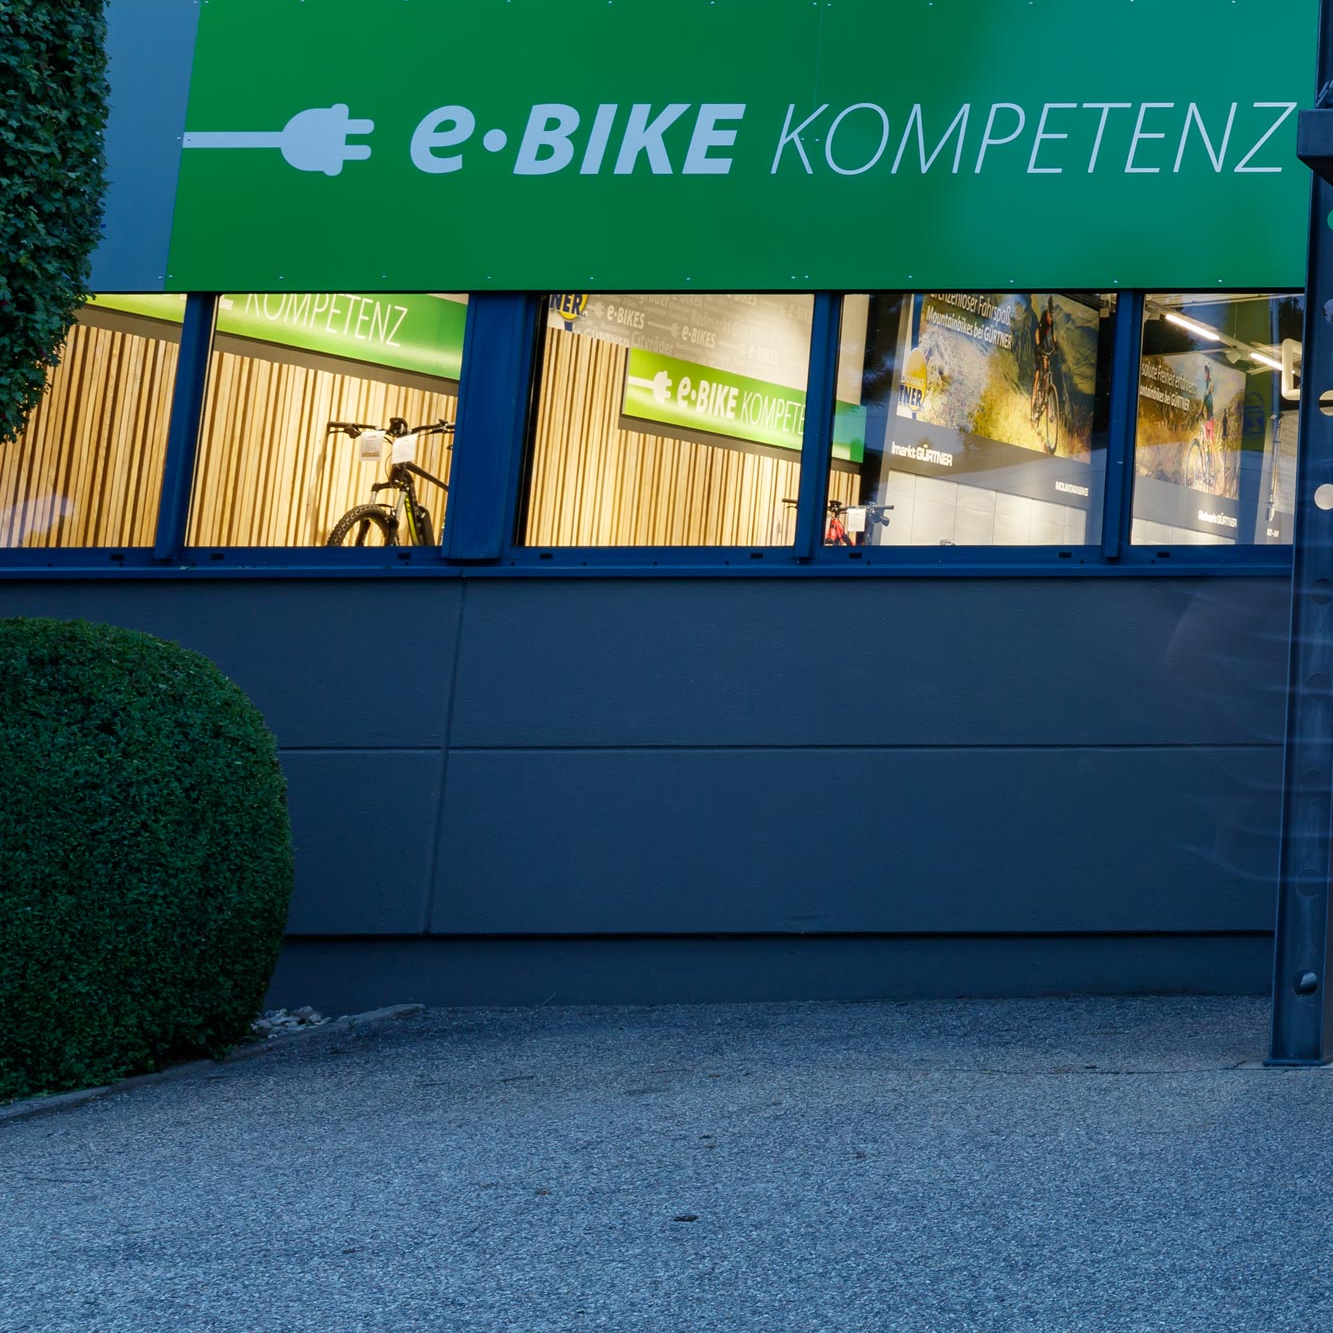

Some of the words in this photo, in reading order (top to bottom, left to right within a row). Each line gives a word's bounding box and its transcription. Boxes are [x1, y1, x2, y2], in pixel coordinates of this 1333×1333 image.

[770, 102, 1297, 176] KOMPETENZ
[926, 305, 973, 336] Mountainbikes
[973, 322, 983, 339] bei
[916, 443, 953, 467] GÜRTNER
